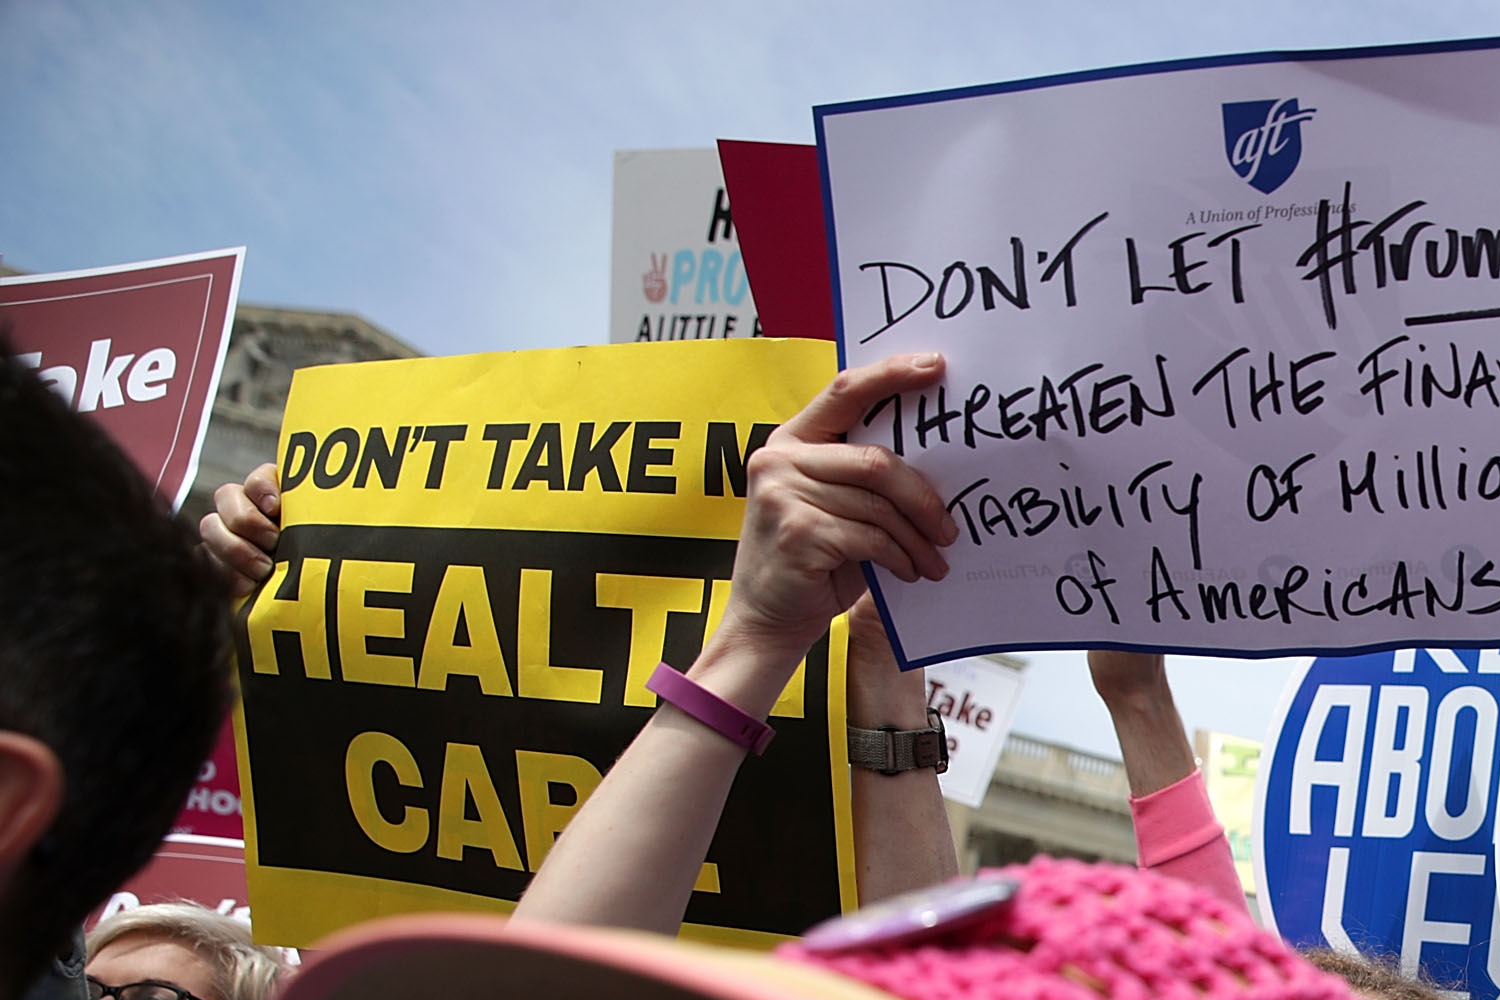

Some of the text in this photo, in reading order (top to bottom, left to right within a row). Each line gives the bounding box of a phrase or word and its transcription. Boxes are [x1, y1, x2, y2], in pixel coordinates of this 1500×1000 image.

[1232, 97, 1317, 184] aft
[1186, 202, 1357, 225] A Union of Professinas
[670, 248, 752, 306] PRO
[861, 212, 1109, 343] DON'T
[1126, 223, 1263, 304] LET
[864, 354, 1175, 457] THREATEN
[1193, 347, 1337, 429] THE
[280, 421, 781, 498] DON'T TAKE M
[947, 460, 1203, 571] TABILITY
[247, 557, 805, 719] HEALT
